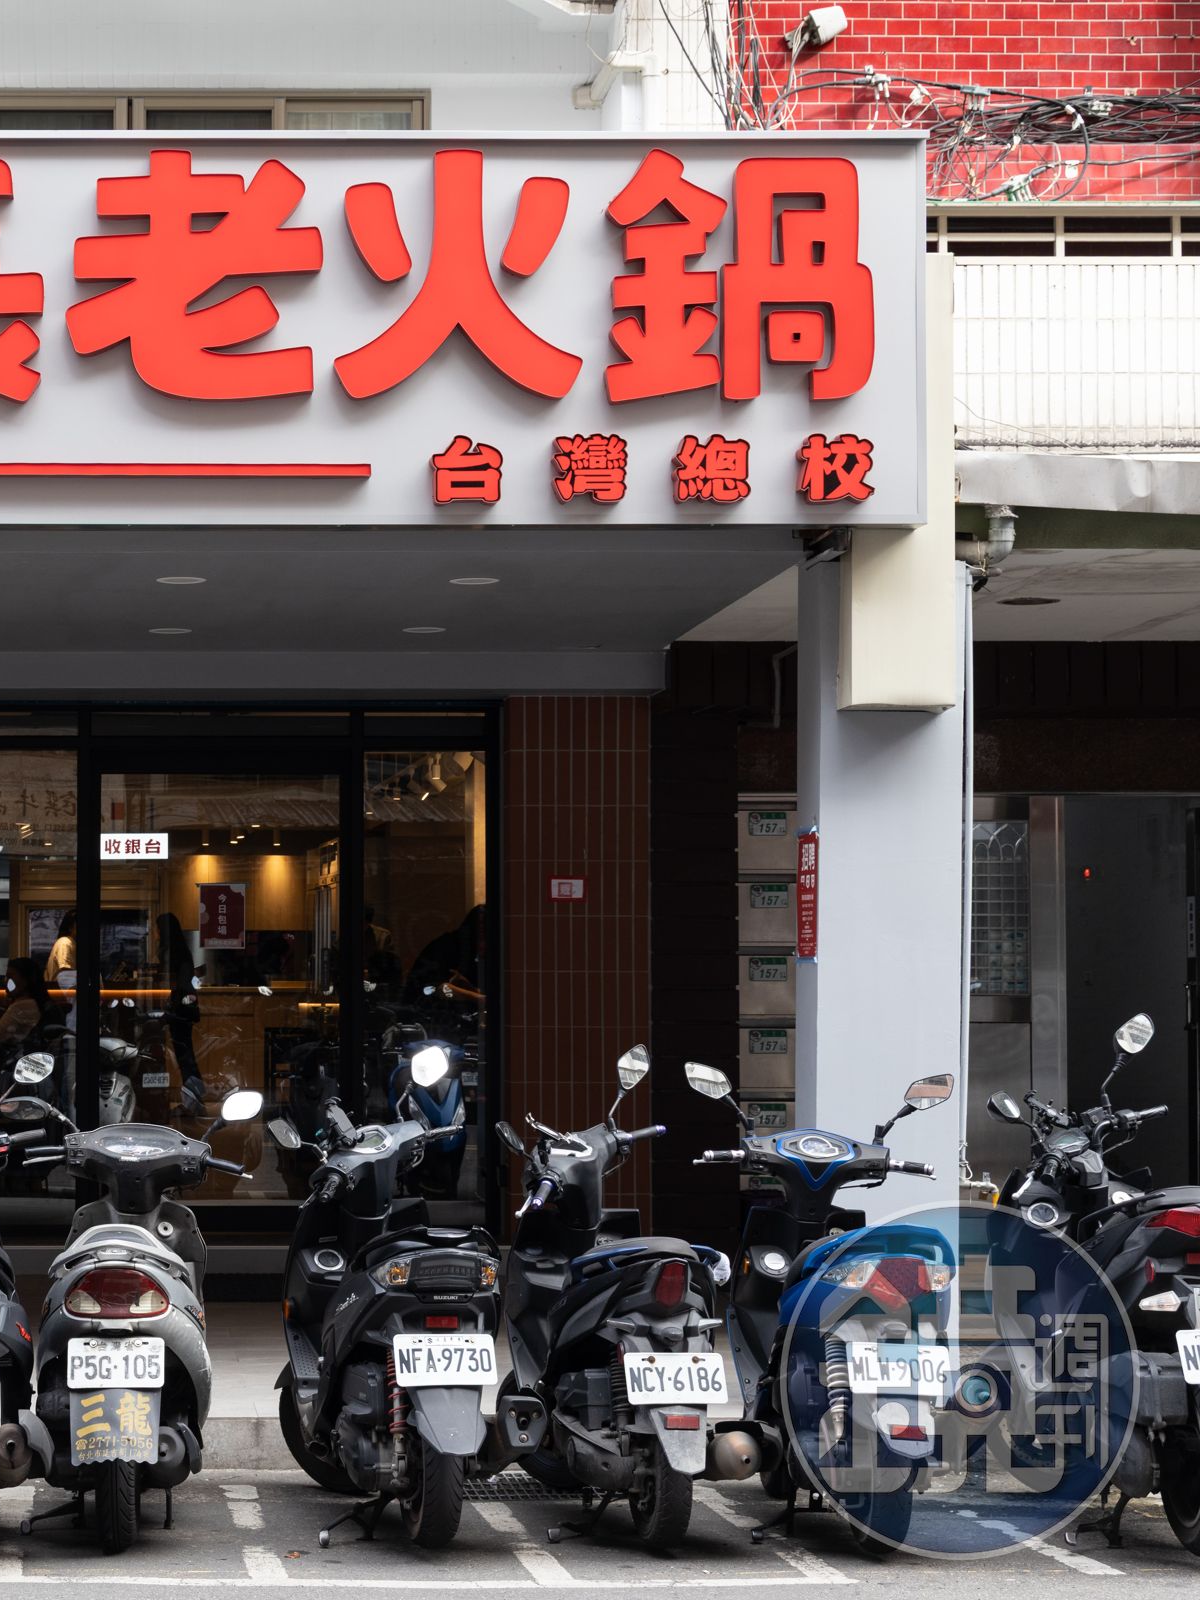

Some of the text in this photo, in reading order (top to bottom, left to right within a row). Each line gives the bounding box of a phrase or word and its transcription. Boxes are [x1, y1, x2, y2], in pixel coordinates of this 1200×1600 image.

[431, 433, 876, 504] 台灣總校
[760, 822, 778, 833] 157
[104, 838, 161, 855] 收銀台
[761, 895, 779, 906] 157
[760, 968, 778, 979] 157
[760, 1040, 778, 1051] 157
[759, 1114, 777, 1125] 157
[76, 1391, 153, 1438] 三龍
